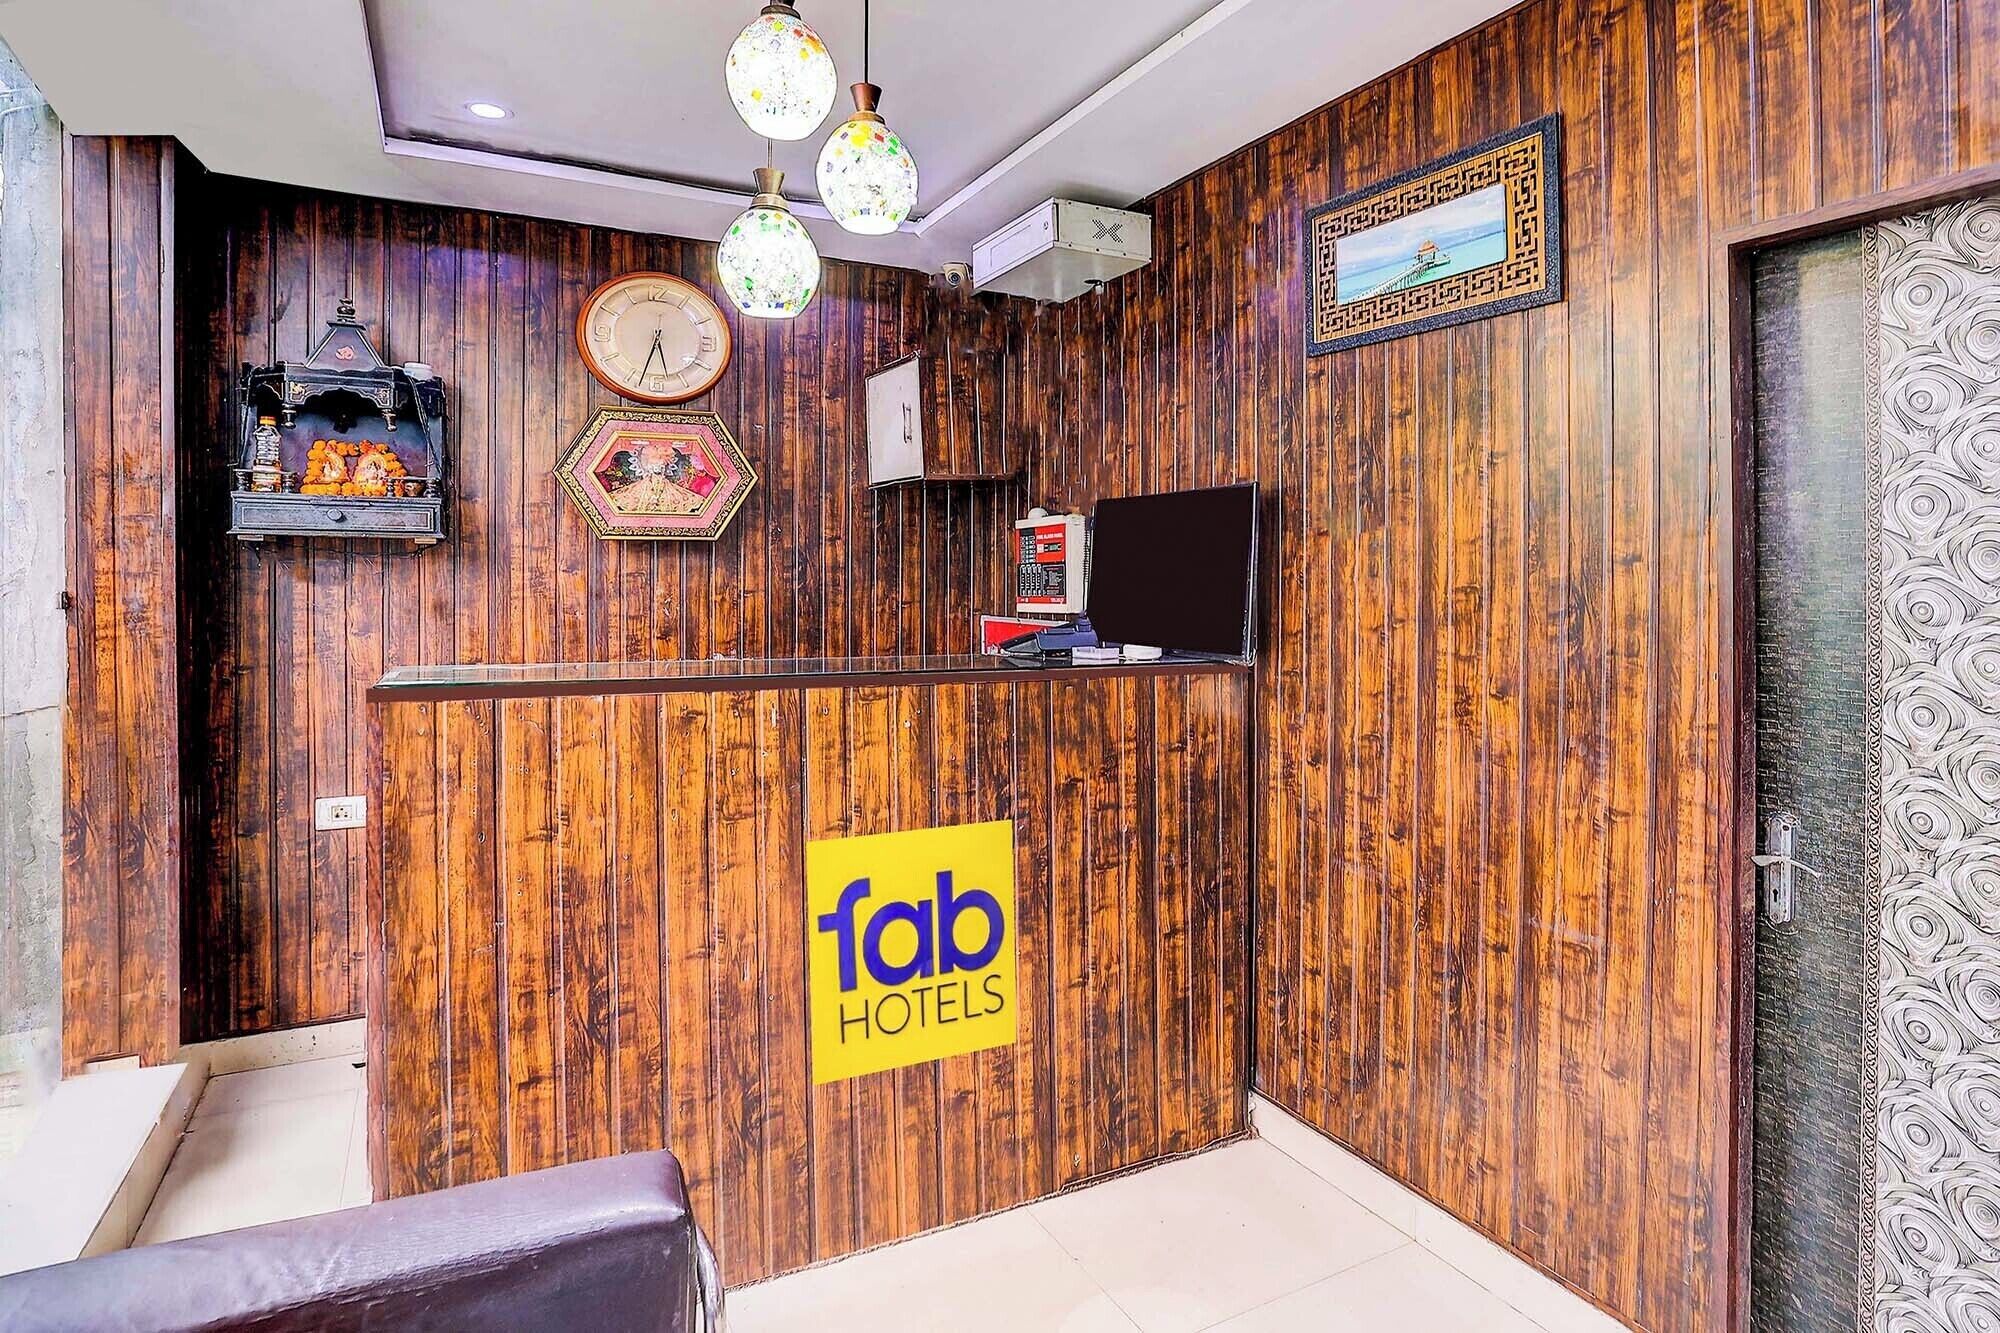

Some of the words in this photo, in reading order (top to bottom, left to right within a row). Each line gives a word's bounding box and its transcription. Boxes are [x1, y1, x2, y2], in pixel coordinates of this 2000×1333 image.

[648, 285, 668, 303] 12
[594, 325, 611, 342] 9
[702, 335, 717, 353] 3
[649, 375, 665, 392] 6
[818, 870, 1005, 992] fab
[840, 974, 1005, 1044] HOTELS
